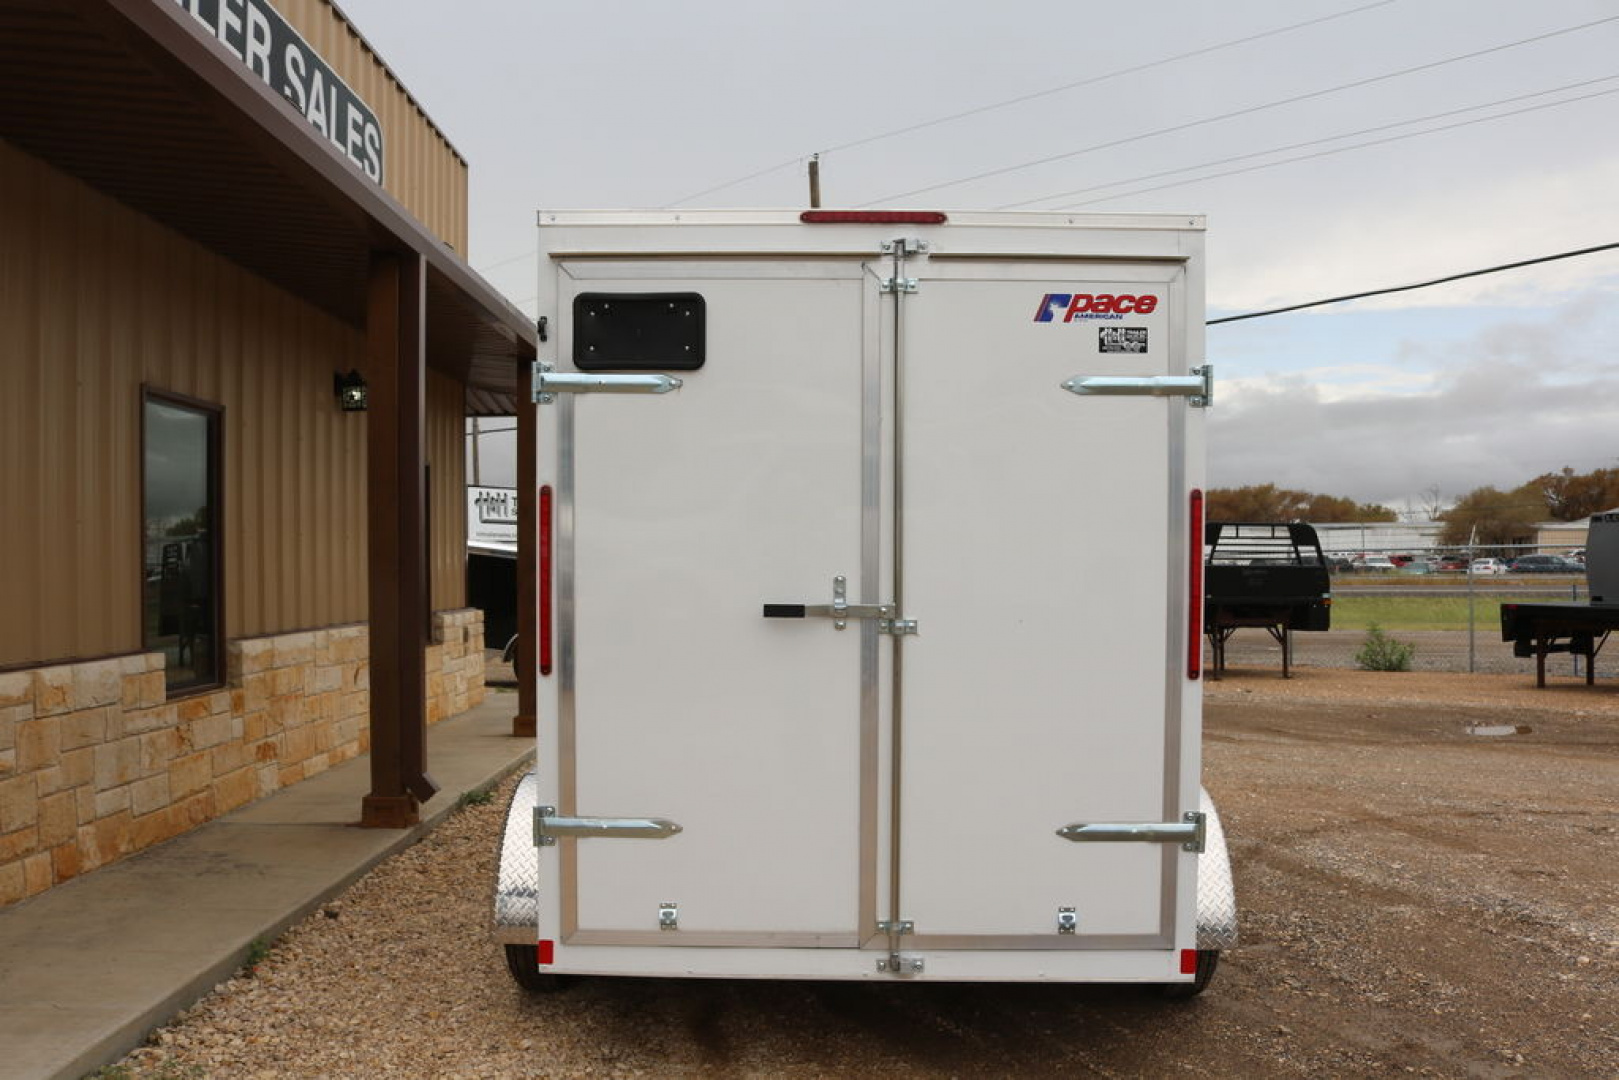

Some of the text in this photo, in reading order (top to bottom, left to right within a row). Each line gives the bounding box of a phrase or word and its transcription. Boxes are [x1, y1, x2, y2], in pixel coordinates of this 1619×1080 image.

[284, 43, 380, 185] SALES
[1063, 294, 1158, 322] pace
[1074, 312, 1123, 320] AMERICAN
